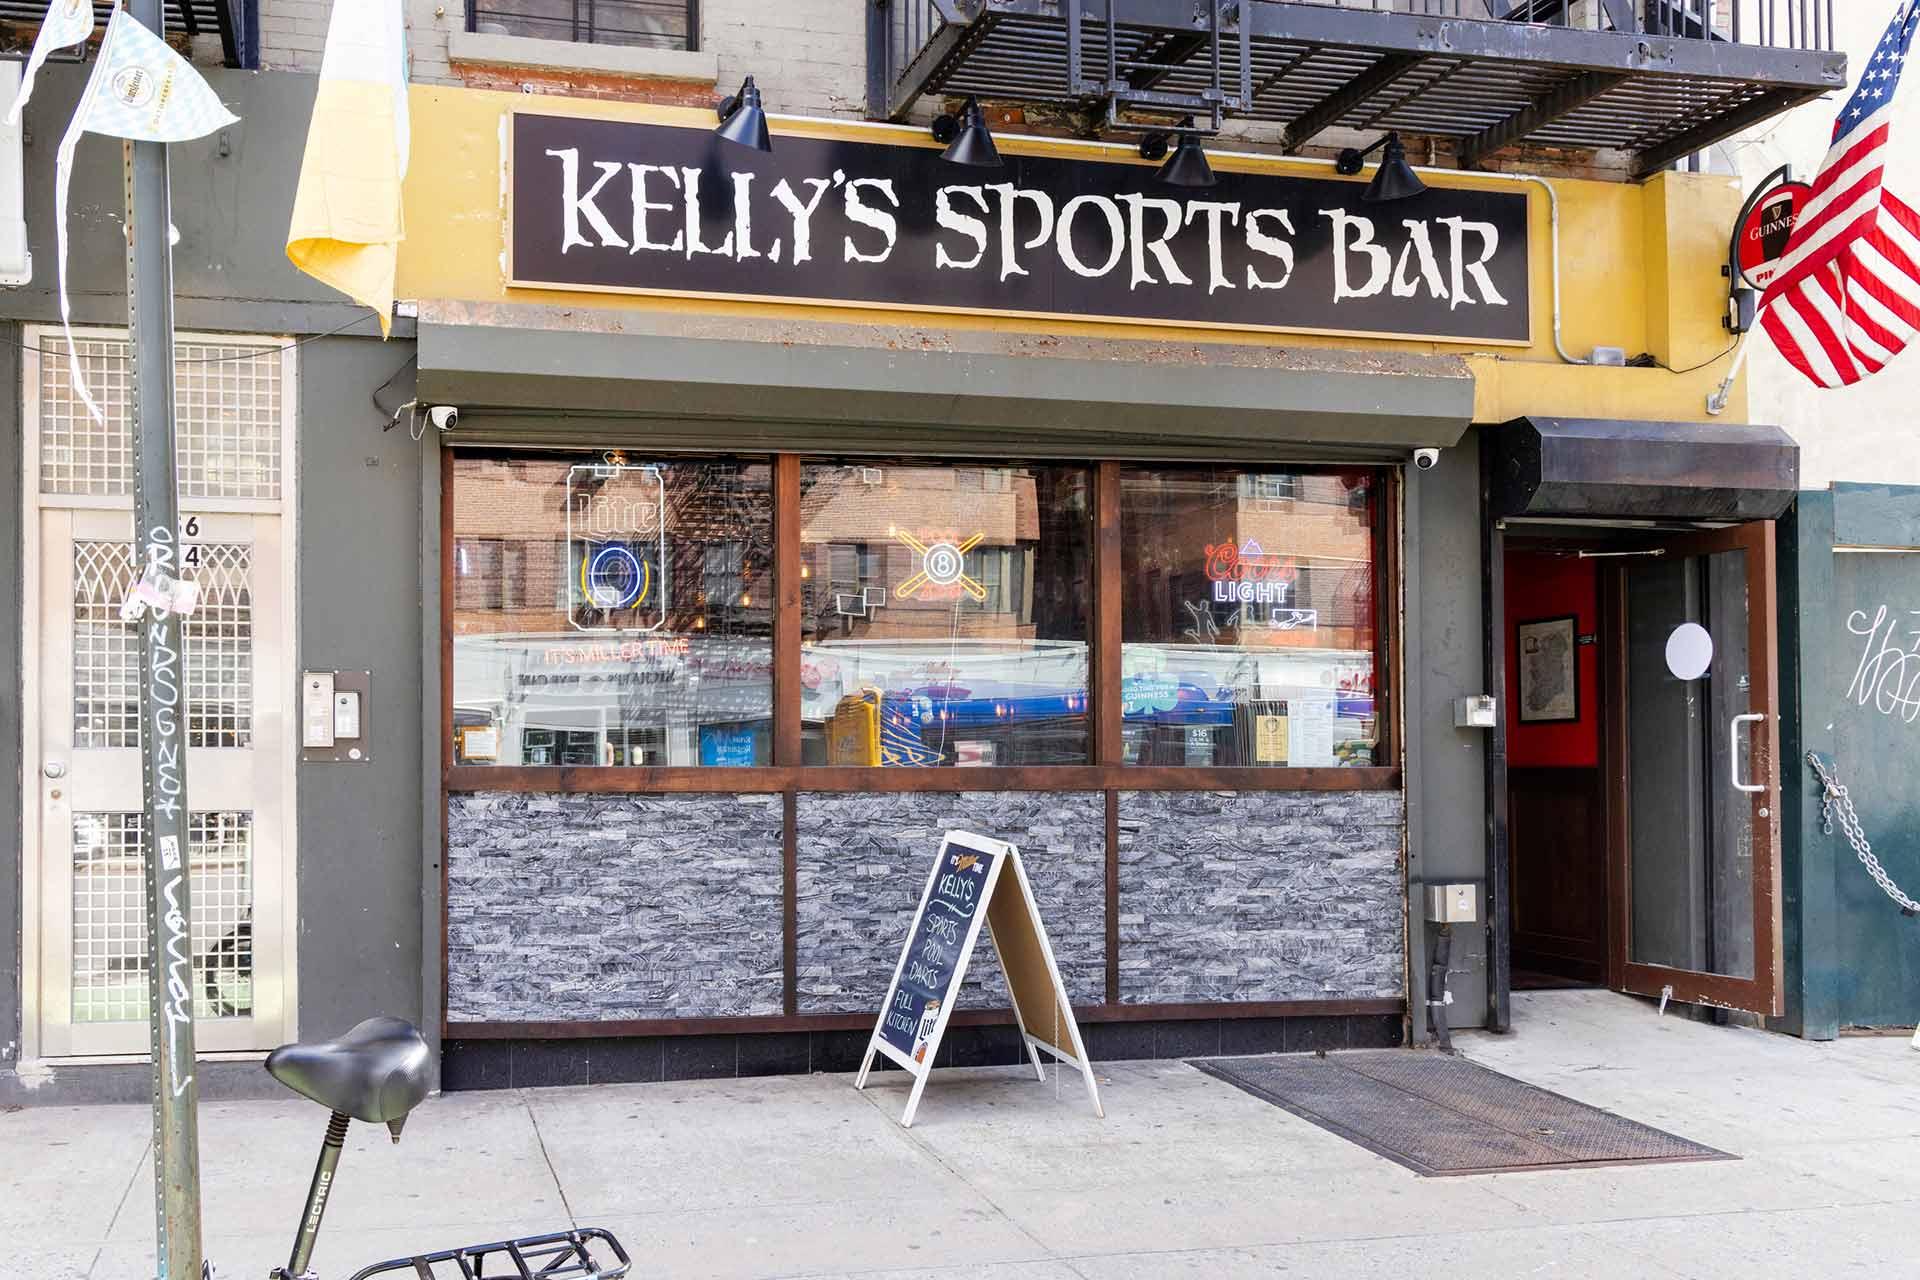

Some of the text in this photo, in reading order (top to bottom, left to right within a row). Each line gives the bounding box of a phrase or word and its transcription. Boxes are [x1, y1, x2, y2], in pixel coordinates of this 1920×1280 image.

[545, 147, 1508, 311] KELLY'S SPORTS BAR
[1750, 213, 1799, 240] GUINNES
[1204, 543, 1297, 583] Coors
[1214, 580, 1289, 603] LIGHT
[576, 643, 643, 662] MILLER
[645, 638, 689, 656] TIME
[938, 873, 976, 901] KELLY'S
[926, 912, 959, 946] SPORTS
[921, 938, 944, 966] POOL
[908, 960, 939, 989] DARTS
[894, 989, 913, 1011] FULL
[886, 1009, 919, 1037] KITCHEN
[306, 1171, 332, 1233] LECTRIC
